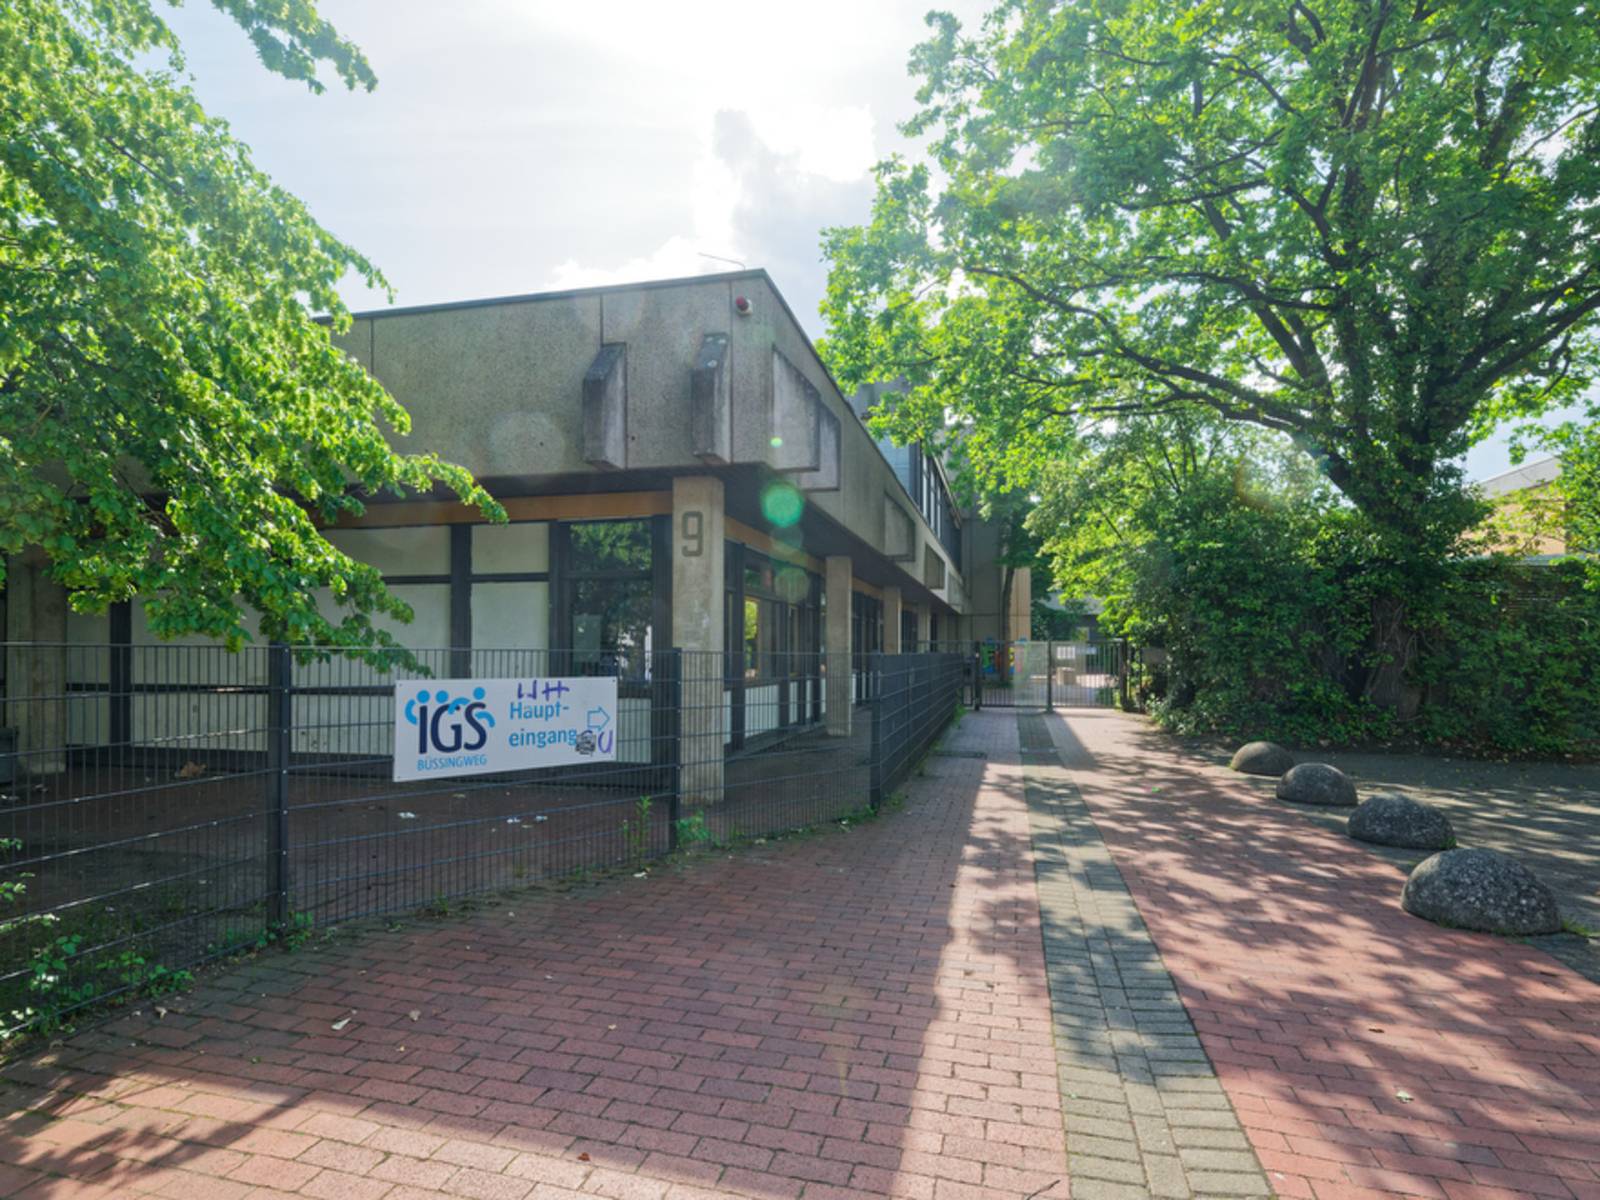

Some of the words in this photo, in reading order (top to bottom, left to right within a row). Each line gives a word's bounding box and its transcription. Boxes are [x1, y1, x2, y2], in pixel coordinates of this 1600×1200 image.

[682, 511, 704, 557] 9
[510, 702, 569, 721] Haupt-
[419, 702, 487, 754] IGS
[509, 728, 577, 748] eingang
[417, 754, 488, 771] BÜSSINGWEG
